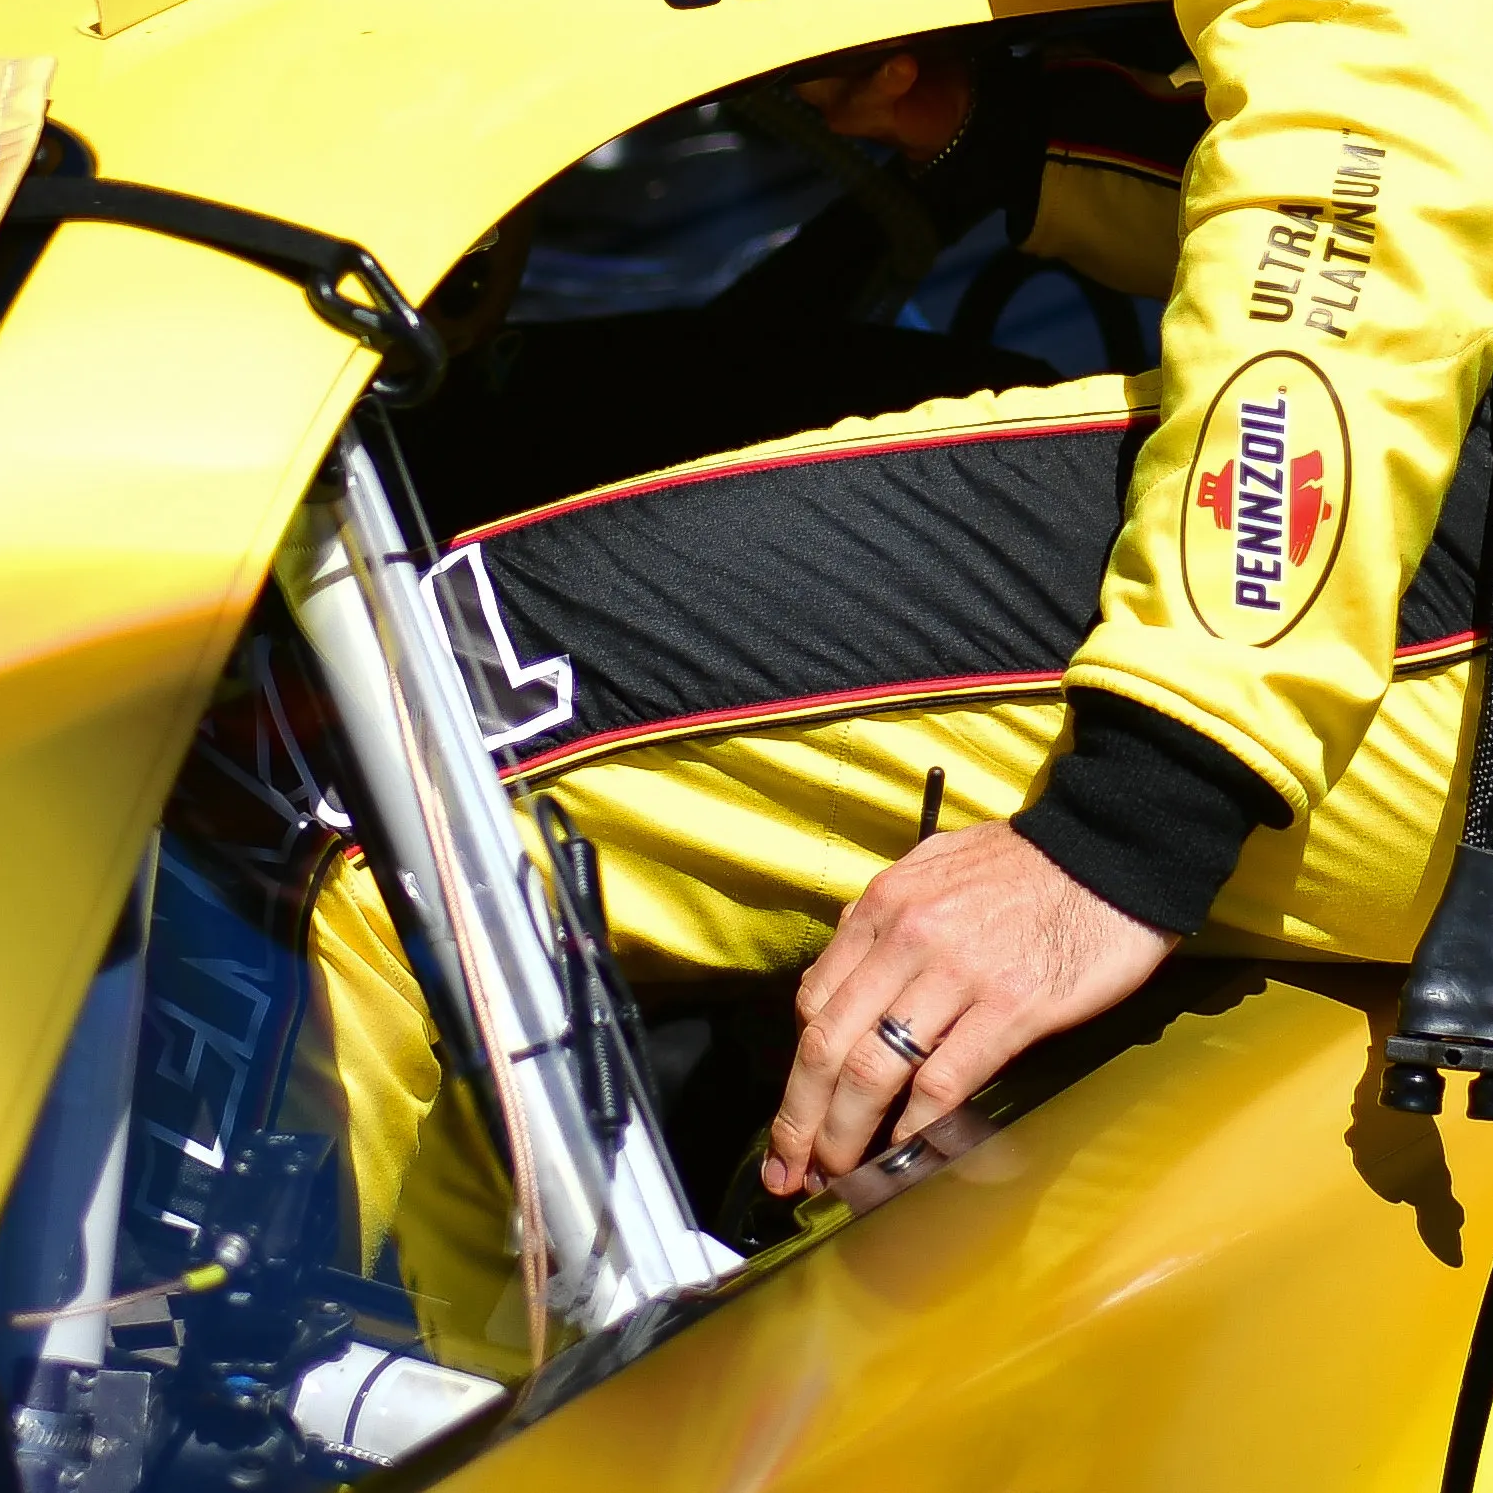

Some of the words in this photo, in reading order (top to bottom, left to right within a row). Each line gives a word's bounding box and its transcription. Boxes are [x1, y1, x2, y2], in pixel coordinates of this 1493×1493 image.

[1248, 204, 1325, 324] ULTRA
[1305, 142, 1387, 340] PLATINUM
[1235, 396, 1288, 612] PENNZOIL
